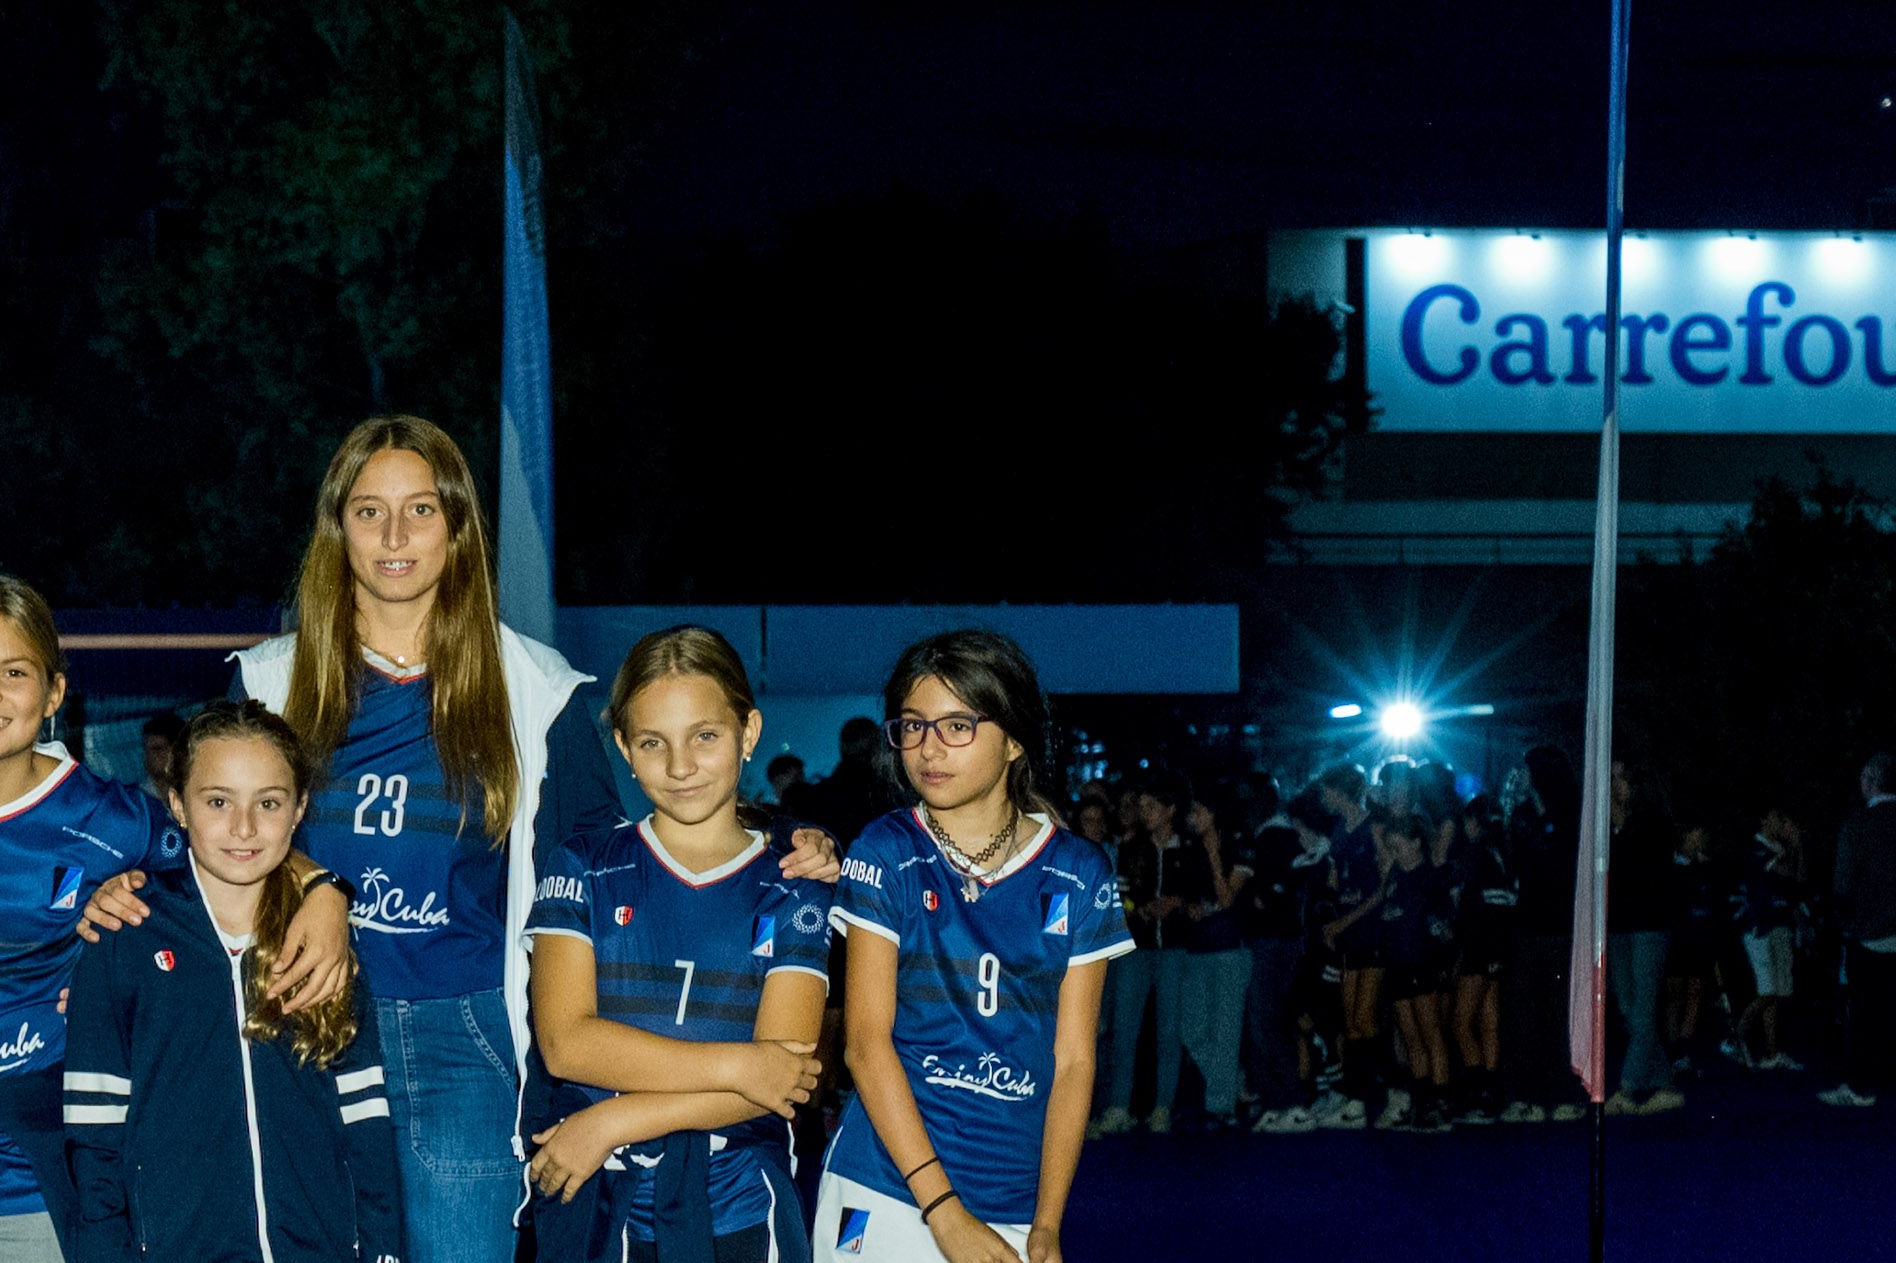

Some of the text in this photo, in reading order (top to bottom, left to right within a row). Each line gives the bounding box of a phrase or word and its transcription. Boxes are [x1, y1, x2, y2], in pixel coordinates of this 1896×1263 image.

[354, 773, 408, 837] 23
[838, 857, 881, 889] OOBAL
[380, 887, 450, 926] Cuba
[674, 959, 695, 1025] 7
[976, 952, 1000, 1017] 9
